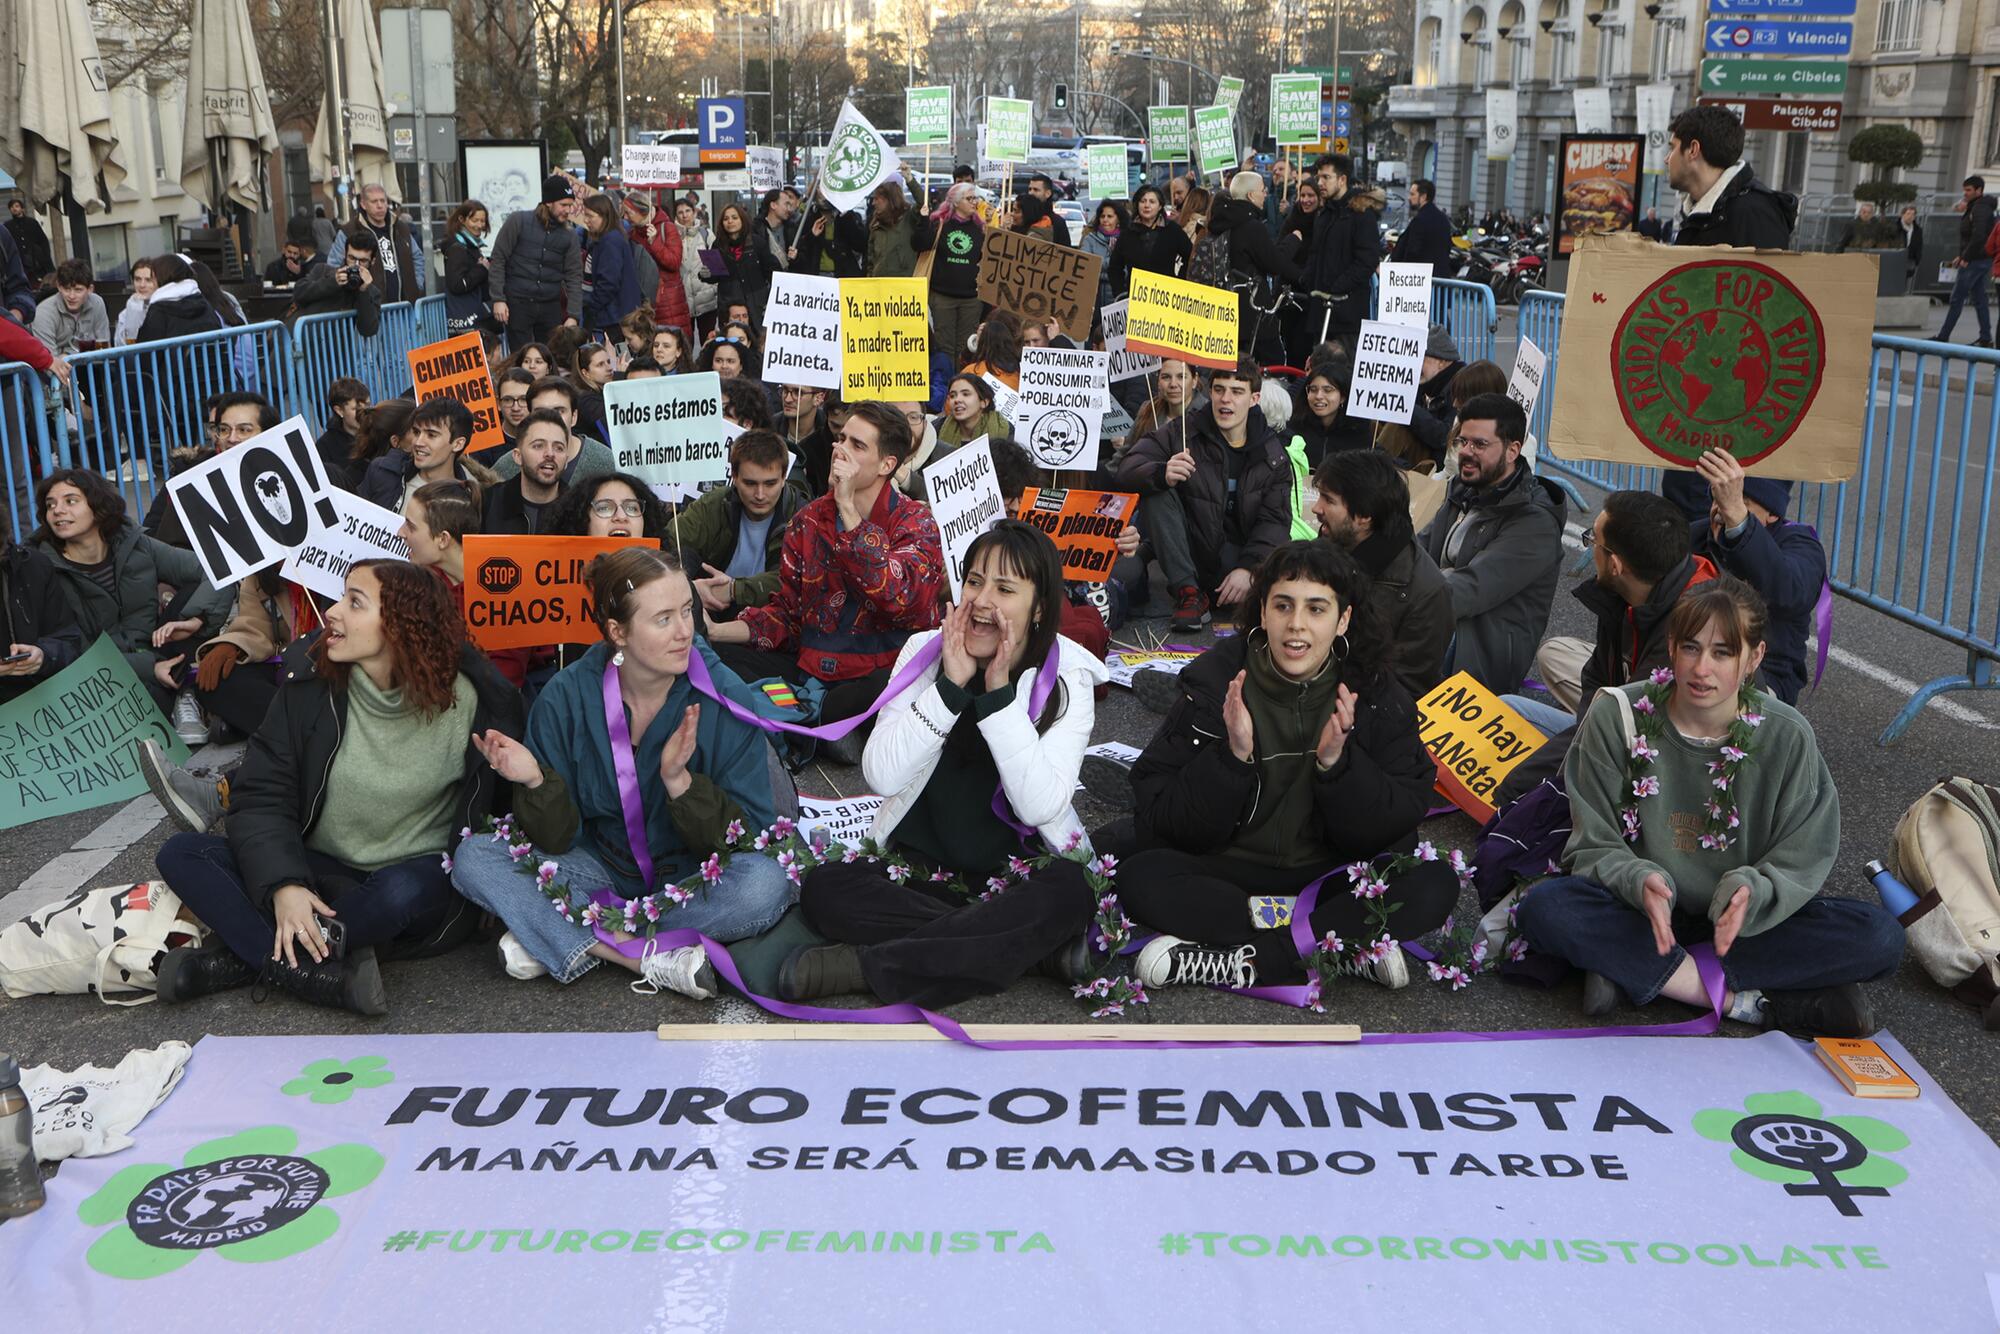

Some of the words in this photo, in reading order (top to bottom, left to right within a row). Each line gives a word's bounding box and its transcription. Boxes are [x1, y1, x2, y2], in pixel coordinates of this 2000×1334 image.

[1787, 31, 1848, 45] Valencia
[1740, 72, 1768, 82] plaza
[1773, 73, 1787, 82] de
[1792, 70, 1841, 83] Cibeles
[910, 97, 947, 107] SAVE
[1218, 87, 1241, 97] SAVE
[1279, 90, 1318, 102] SAVE
[991, 110, 1026, 121] SAVE
[1279, 111, 1318, 122] SAVE
[1280, 102, 1291, 111] THE
[1292, 101, 1317, 111] PLANET
[1772, 105, 1816, 116] Palacio
[1822, 107, 1838, 117] de
[708, 105, 735, 144] P
[910, 116, 947, 125] SAVE
[1151, 116, 1185, 126] SAVE
[1152, 124, 1163, 134] THE
[1164, 124, 1186, 134] PLANET
[1199, 117, 1229, 131] SAVE
[1210, 126, 1230, 138] PLANET
[1791, 117, 1836, 128] Cibeles
[720, 135, 735, 144] 24h
[859, 131, 877, 152] FOR
[990, 129, 1026, 140] SAVE
[1152, 134, 1187, 144] SAVE
[1201, 137, 1232, 151] SAVE
[624, 148, 650, 165] Change
[651, 151, 667, 165] your
[1091, 155, 1124, 164] SAVE
[1567, 143, 1636, 171] CHEESY
[624, 169, 635, 178] no
[635, 170, 651, 181] your
[852, 154, 880, 188] FUTURE
[1091, 172, 1124, 181] SAVE
[986, 231, 1090, 280] CLIMATE
[986, 257, 1078, 302] JUSTICE
[1388, 270, 1426, 287] Rescatar
[775, 286, 790, 306] La
[793, 292, 840, 313] avaricia
[997, 282, 1079, 330] NOW
[1131, 278, 1148, 303] Los
[1149, 283, 1170, 309] ricos
[1171, 291, 1216, 320] contaminan
[1216, 301, 1237, 327] más,
[1385, 297, 1393, 313] al
[1394, 296, 1427, 316] Planeta,
[1715, 271, 1775, 319] FOR
[846, 296, 863, 322] Ya,
[864, 299, 881, 317] tan
[884, 295, 925, 321] violada,
[771, 320, 817, 340] mata
[822, 324, 838, 342] al
[846, 332, 855, 354] la
[858, 330, 891, 353] madre
[892, 330, 925, 352] Tierra
[1127, 317, 1166, 341] matando
[1167, 322, 1184, 346] más
[1185, 331, 1190, 347] a
[1190, 327, 1203, 351] los
[1204, 330, 1236, 356] demás.
[1362, 333, 1387, 351] ESTE
[1388, 336, 1419, 358] CLIMA
[1625, 285, 1690, 412] FRIDAYS
[415, 345, 484, 384] CLIMATE
[767, 347, 834, 372] planeta.
[1108, 351, 1122, 376] NO
[1123, 348, 1136, 373] TU
[848, 372, 865, 388] sus
[867, 366, 892, 393] hijos
[895, 368, 926, 387] mata.
[1357, 361, 1414, 386] ENFERMA
[1742, 315, 1811, 439] FUTURE
[610, 402, 651, 426] Todos
[654, 397, 717, 422] estamos
[1355, 388, 1365, 407] Y
[1366, 390, 1409, 414] MATA.
[1656, 412, 1734, 450] MADRID
[618, 449, 633, 467] en
[634, 444, 643, 466] el
[645, 442, 682, 465] mismo
[685, 438, 723, 462] barco.
[931, 453, 990, 504] Protégete
[175, 428, 340, 582] NO!
[943, 487, 1000, 551] protegiendo
[1058, 512, 1124, 539] planeta
[295, 547, 325, 570] para
[484, 566, 516, 584] STOP
[469, 597, 571, 627] CHAOS,
[15, 721, 39, 746] A
[33, 667, 124, 738] CALENTAR
[1427, 686, 1483, 722] ¡No
[1477, 714, 1532, 763] hay
[0, 752, 27, 780] UE
[71, 718, 107, 755] TU
[18, 779, 59, 807] AL
[824, 814, 875, 830] Earth.
[385, 1086, 809, 1128] FUTURO
[841, 1087, 1674, 1133] ECOFEMINISTA
[416, 1141, 719, 1172] MAÑANA
[747, 1138, 918, 1171] SERÁ
[946, 1147, 1376, 1176] DEMASIADO
[1397, 1152, 1629, 1181] TARDE
[219, 1157, 278, 1174] FOR
[277, 1161, 320, 1209] FUTURE
[159, 1220, 268, 1246] MADRID
[383, 1229, 1056, 1257] #FUTUROECOFEMINISTA
[1158, 1232, 1891, 1269] #TOMORROWISTOOLATE
